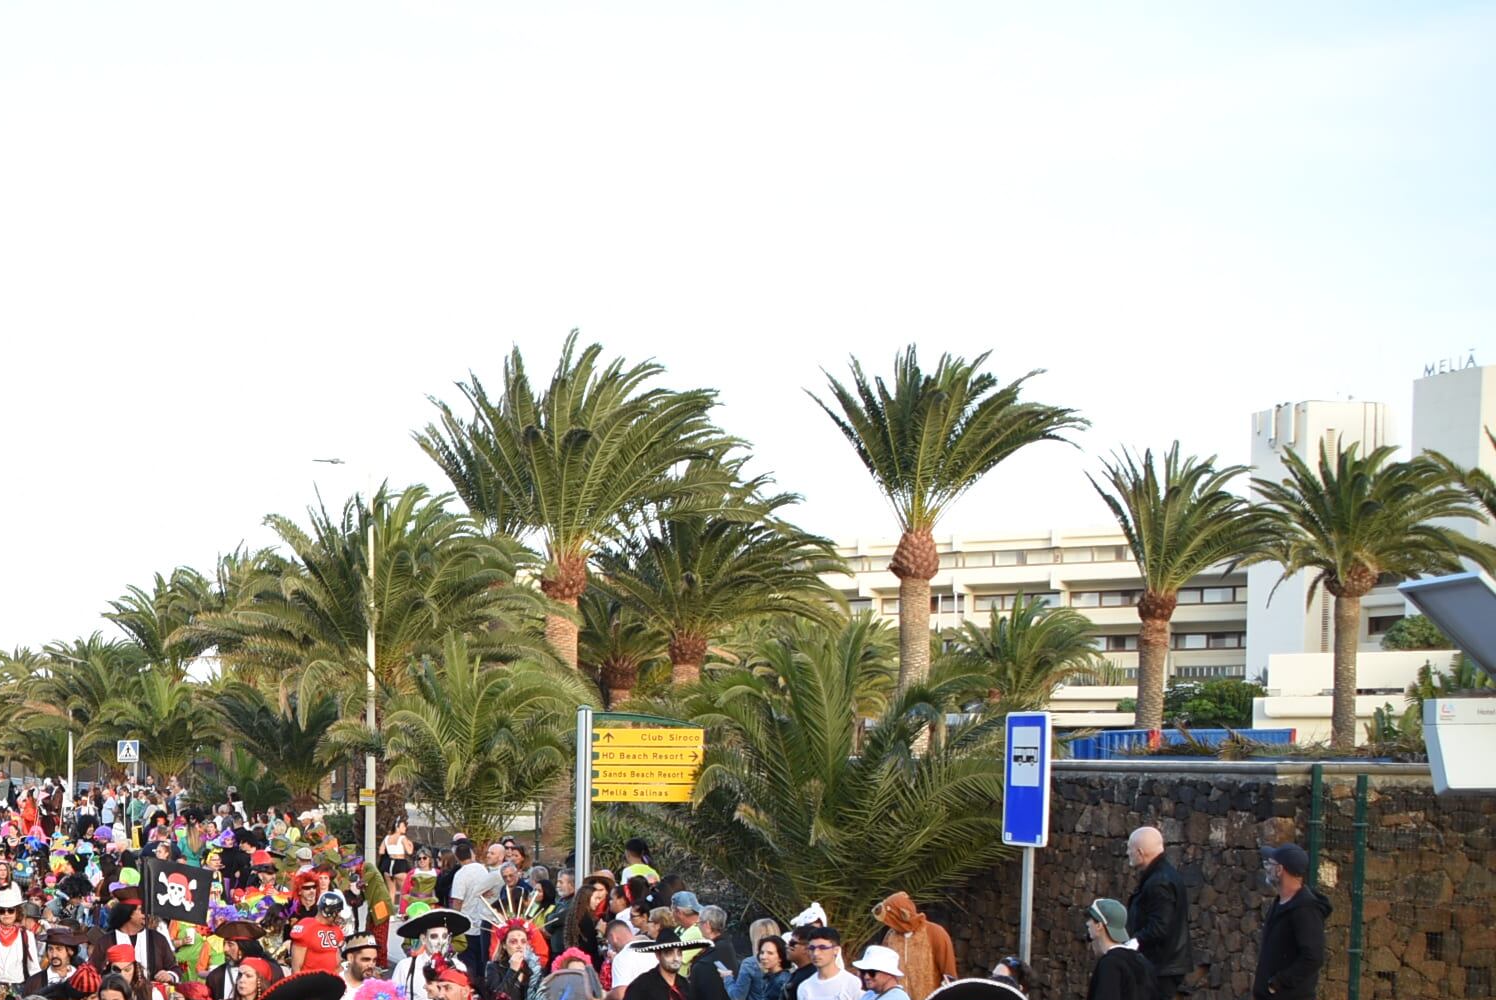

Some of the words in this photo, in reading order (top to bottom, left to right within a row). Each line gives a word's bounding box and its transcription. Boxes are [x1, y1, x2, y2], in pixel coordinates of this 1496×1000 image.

[641, 733, 664, 741] Club
[669, 733, 700, 742] Siroco
[602, 752, 615, 760] HD
[619, 752, 648, 760] Beach
[652, 752, 684, 760] Resort
[602, 770, 627, 778] Sands
[630, 770, 655, 778] Beach
[658, 770, 684, 778] Resort
[633, 788, 669, 797] Salinas
